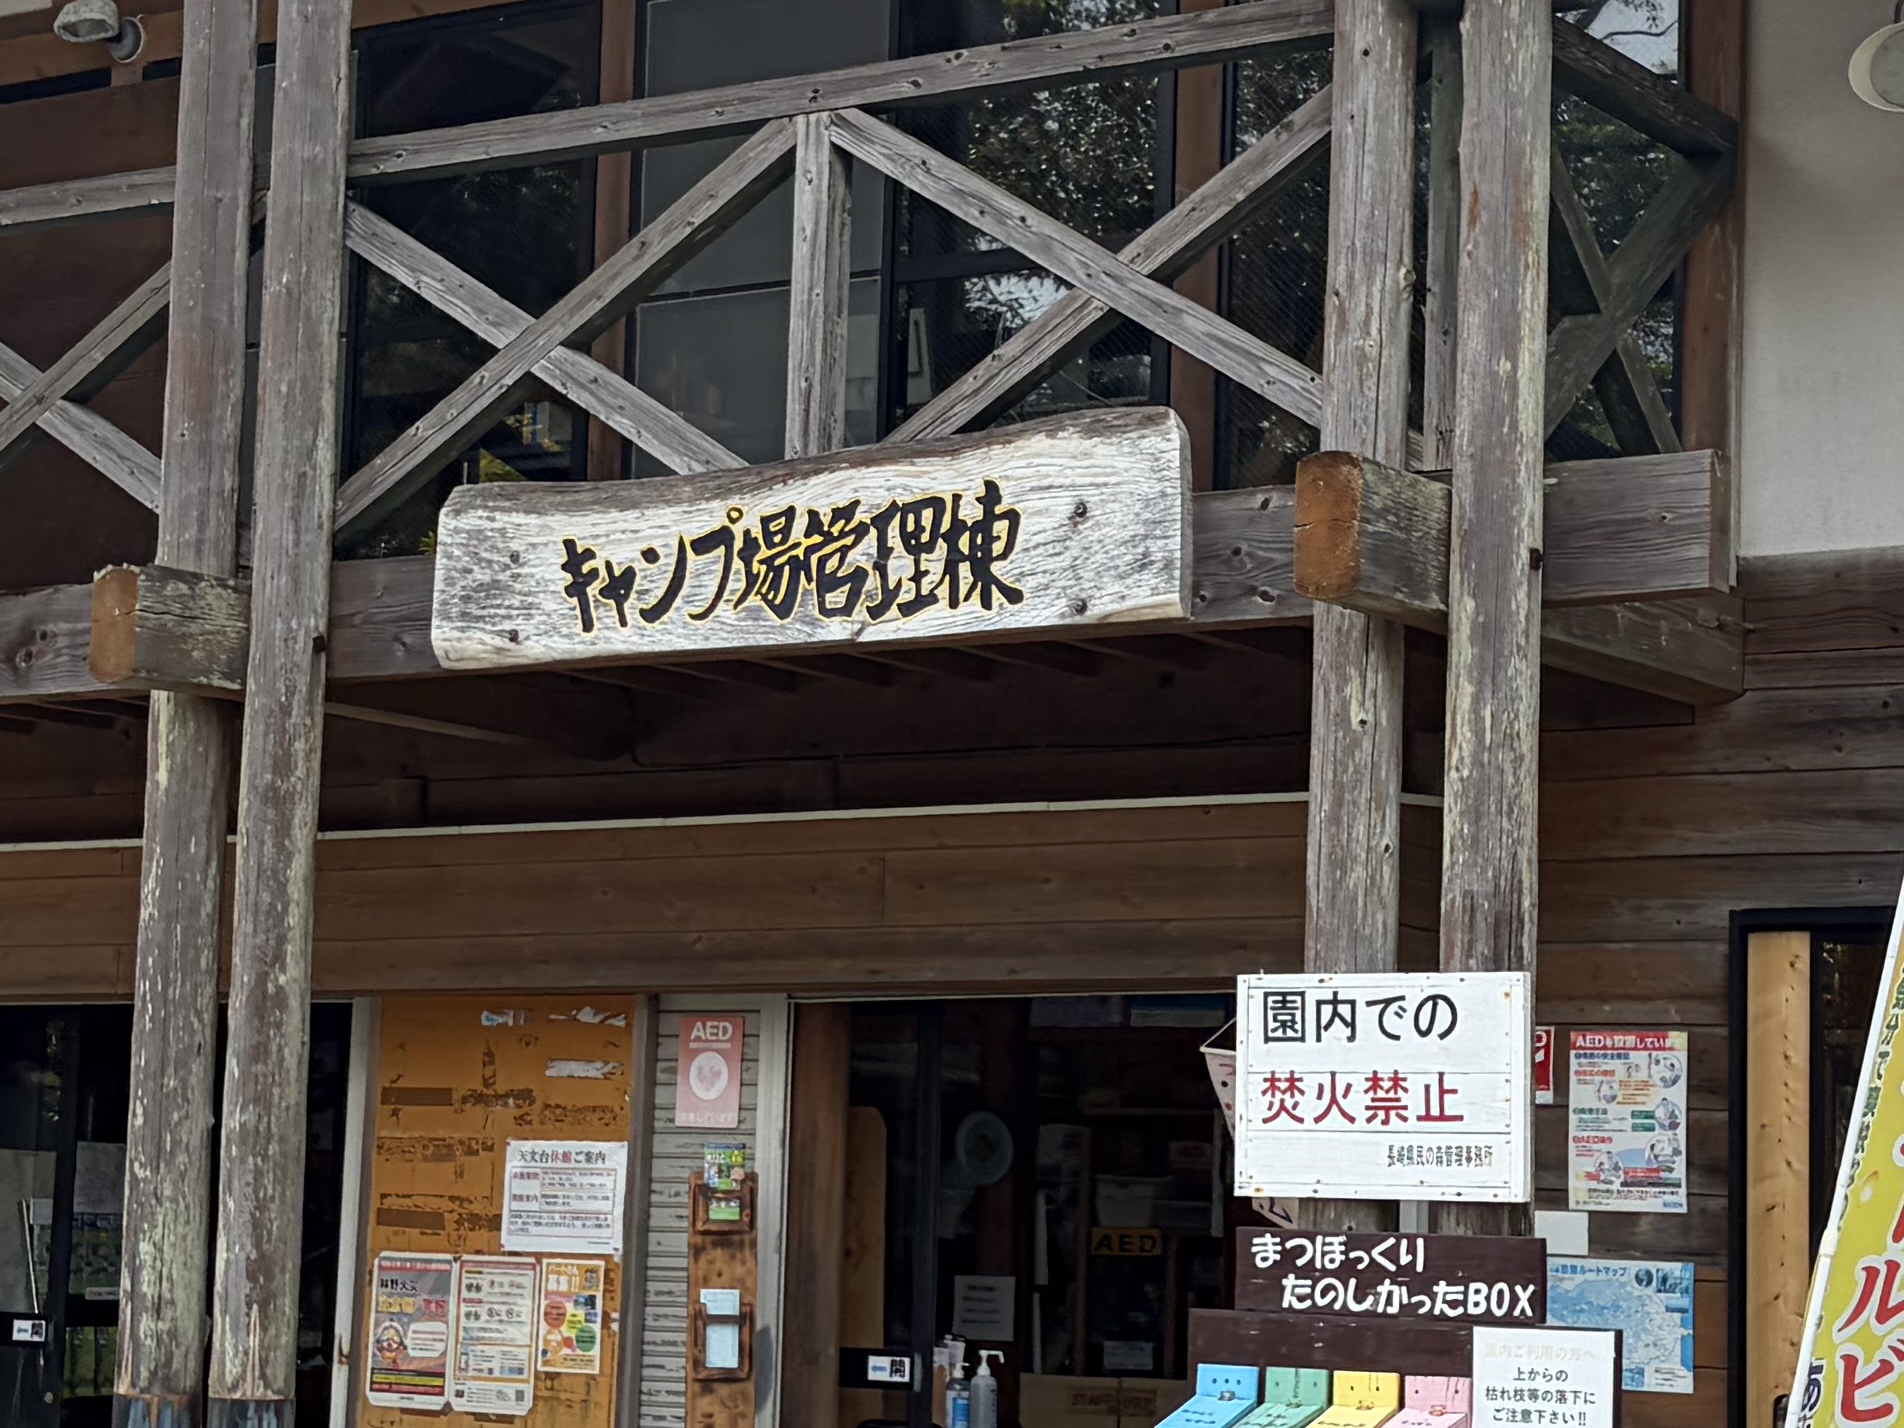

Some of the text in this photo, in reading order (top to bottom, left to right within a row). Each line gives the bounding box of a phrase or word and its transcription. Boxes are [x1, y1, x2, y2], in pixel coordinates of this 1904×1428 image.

[1262, 990, 1459, 1045] 園内での
[690, 1021, 734, 1041] AED
[1260, 1069, 1465, 1126] 焚火禁止
[518, 1149, 607, 1164] 天文台休館ご案内
[1094, 1232, 1158, 1254] AED
[1250, 1232, 1425, 1272] まつぼっくり
[1281, 1273, 1536, 1318] たのしかったBOX
[1513, 1366, 1569, 1383] 上からの
[1485, 1385, 1596, 1405] 枯れ枝等の落下に
